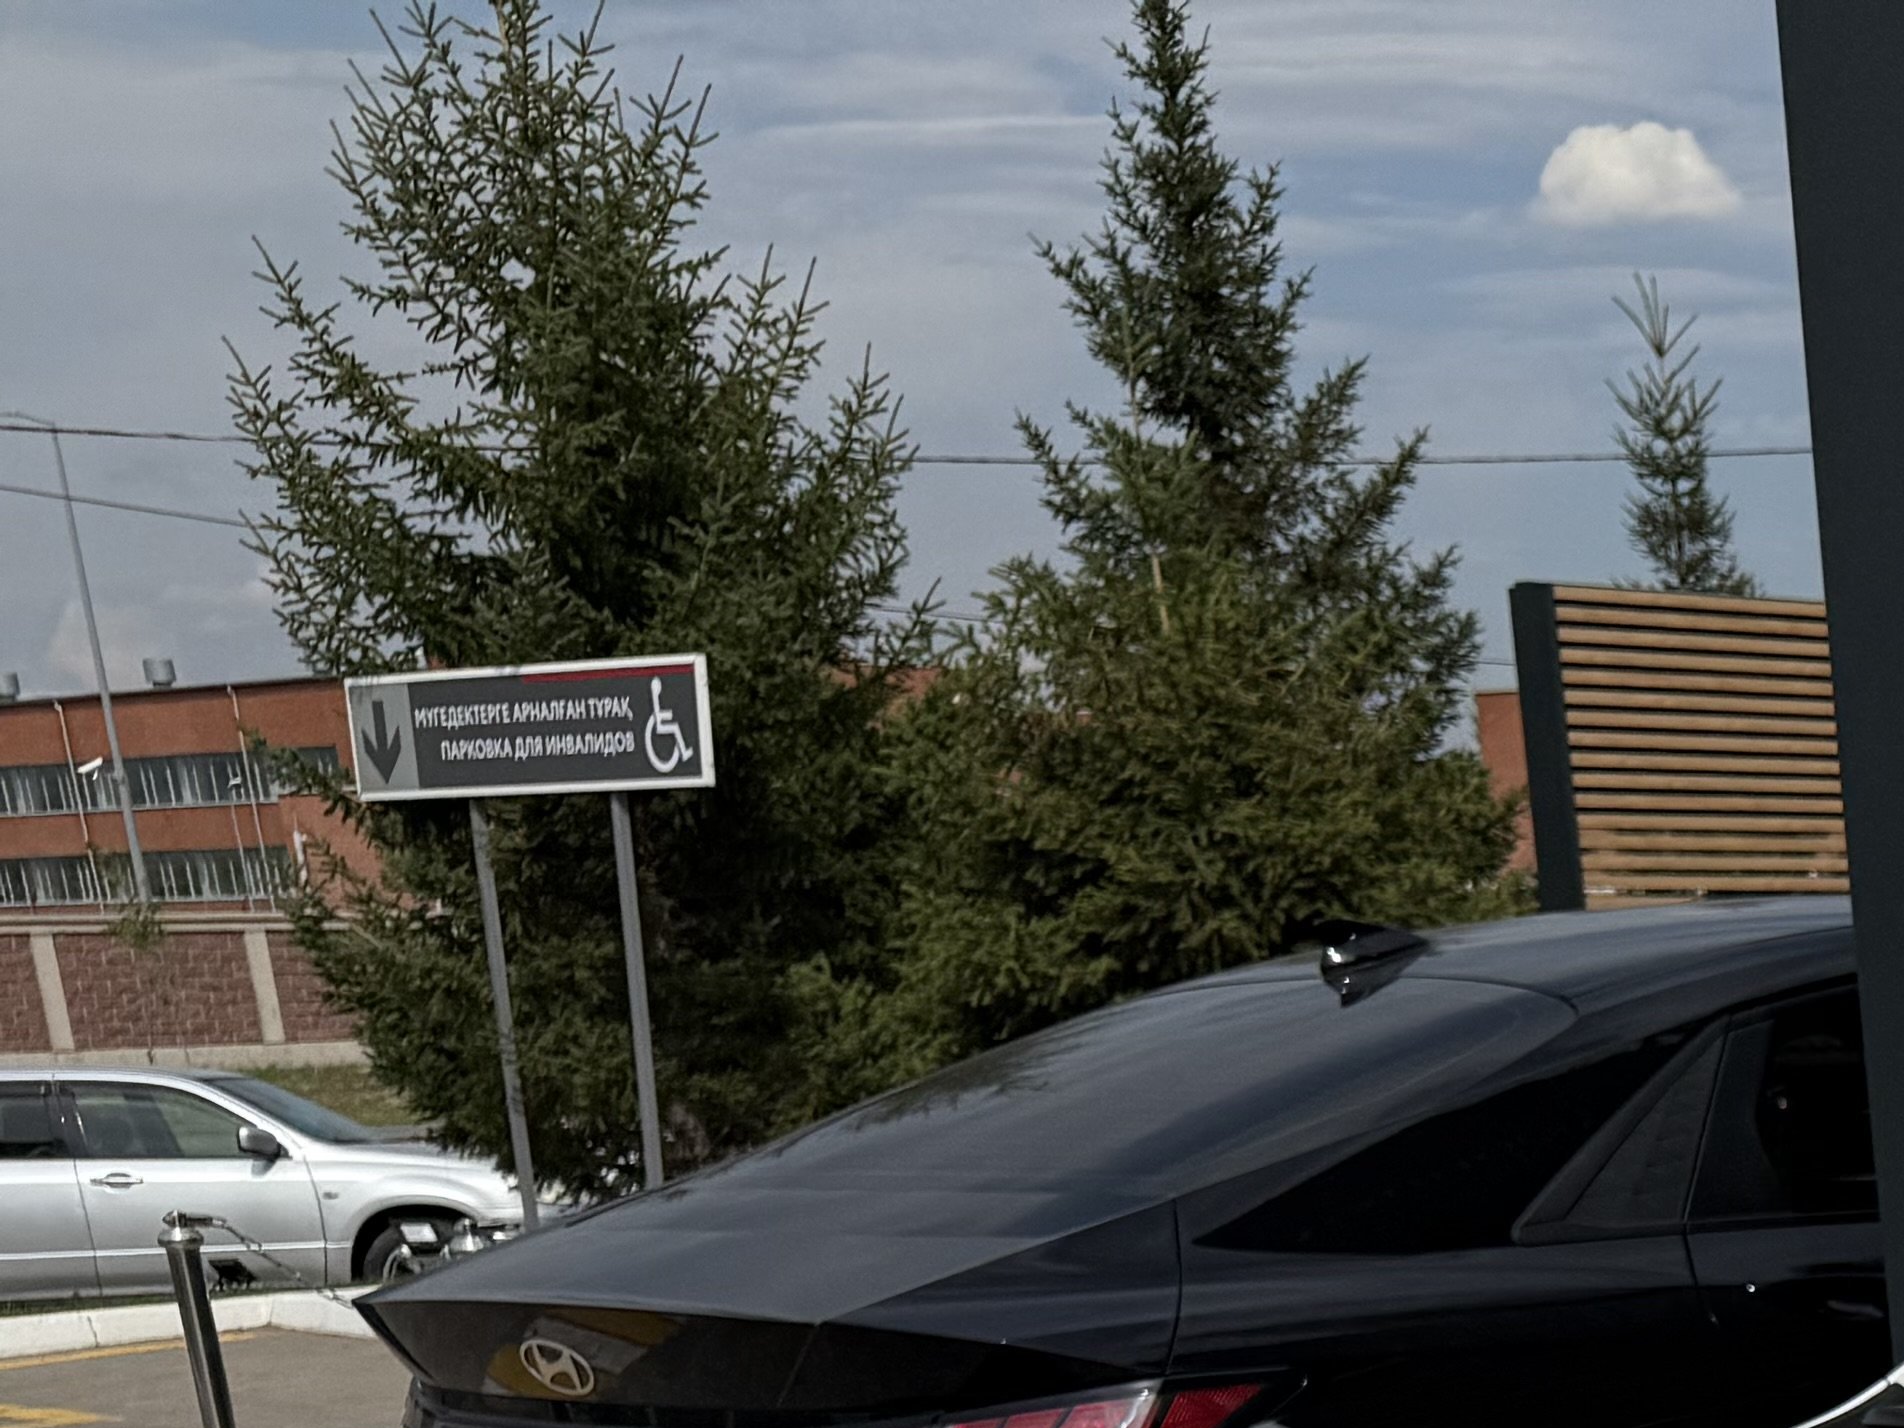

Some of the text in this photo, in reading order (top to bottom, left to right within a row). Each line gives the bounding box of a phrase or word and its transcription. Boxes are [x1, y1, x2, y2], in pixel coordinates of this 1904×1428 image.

[440, 730, 636, 762] ПАРКОВКА ДЛЯ ИНВАЛИДОВ
